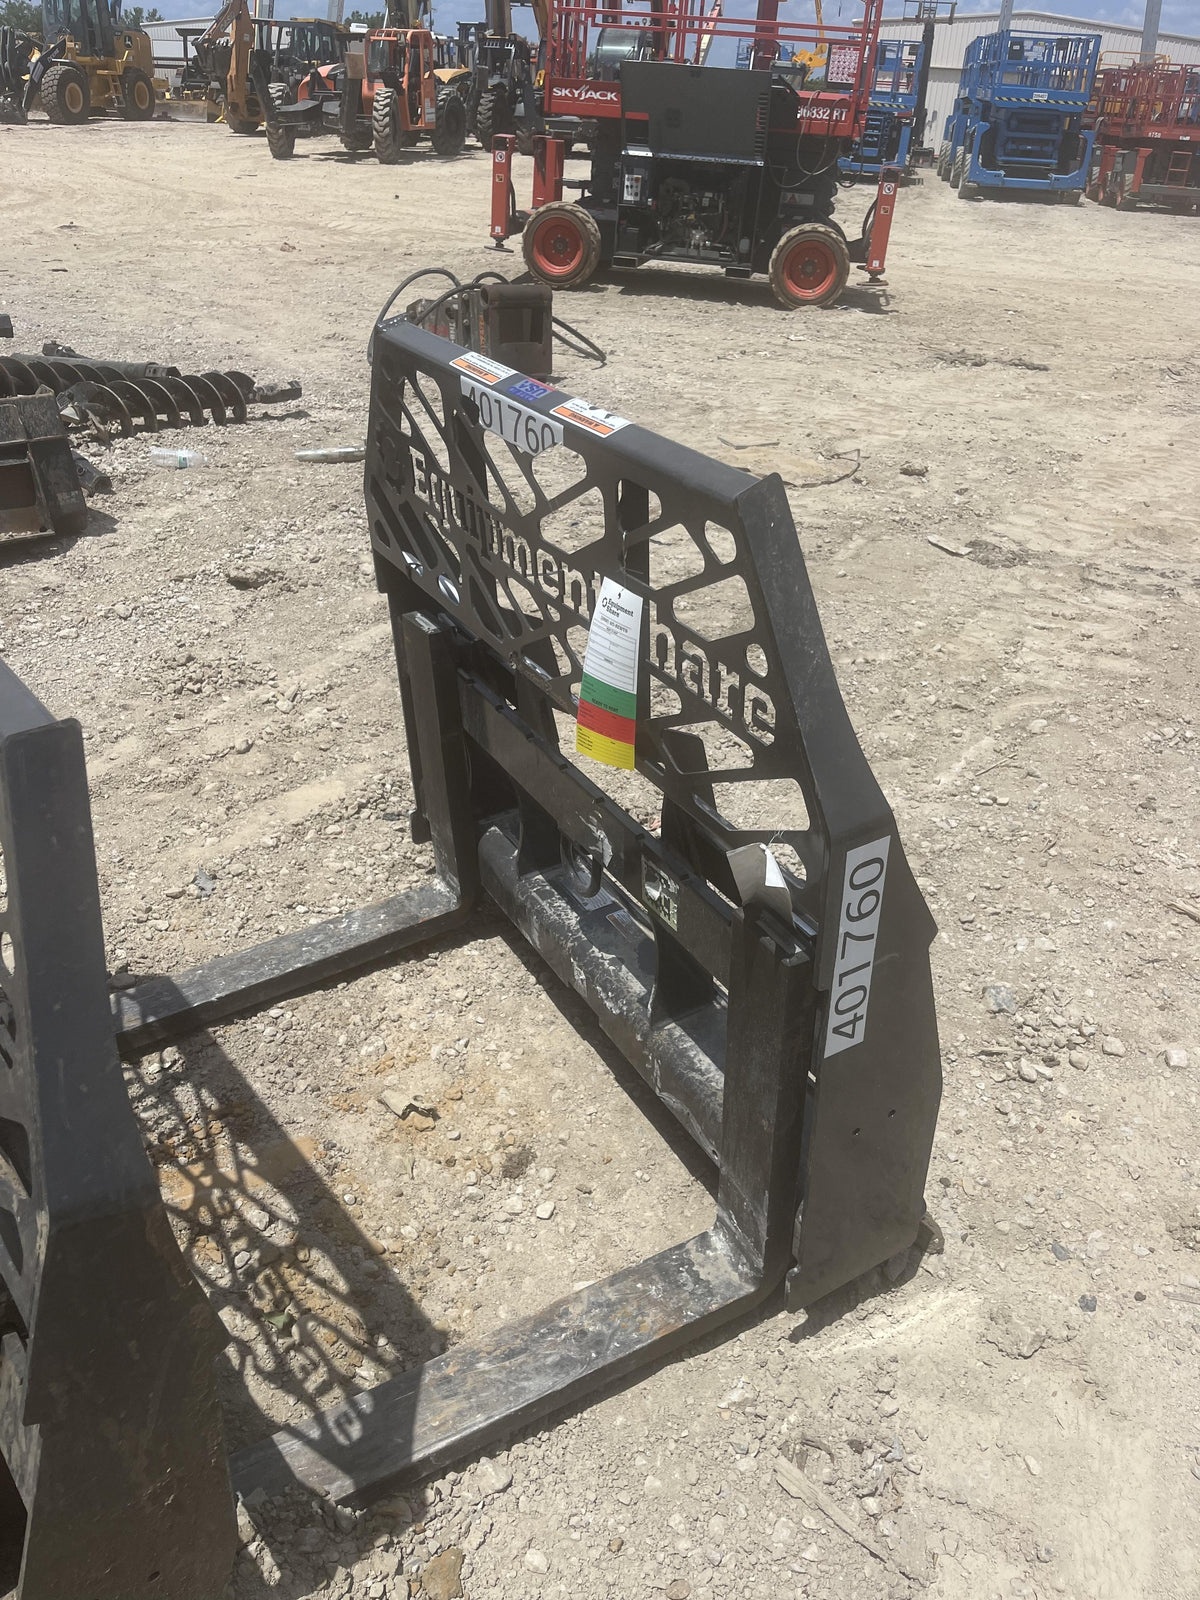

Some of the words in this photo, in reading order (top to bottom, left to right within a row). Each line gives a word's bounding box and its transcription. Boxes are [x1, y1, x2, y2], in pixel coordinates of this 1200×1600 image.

[552, 84, 618, 101] SKYJACK
[833, 107, 849, 121] RT
[519, 380, 548, 397] USA
[605, 605, 620, 618] Share
[608, 598, 634, 617] Equipment
[831, 857, 884, 1039] 401760
